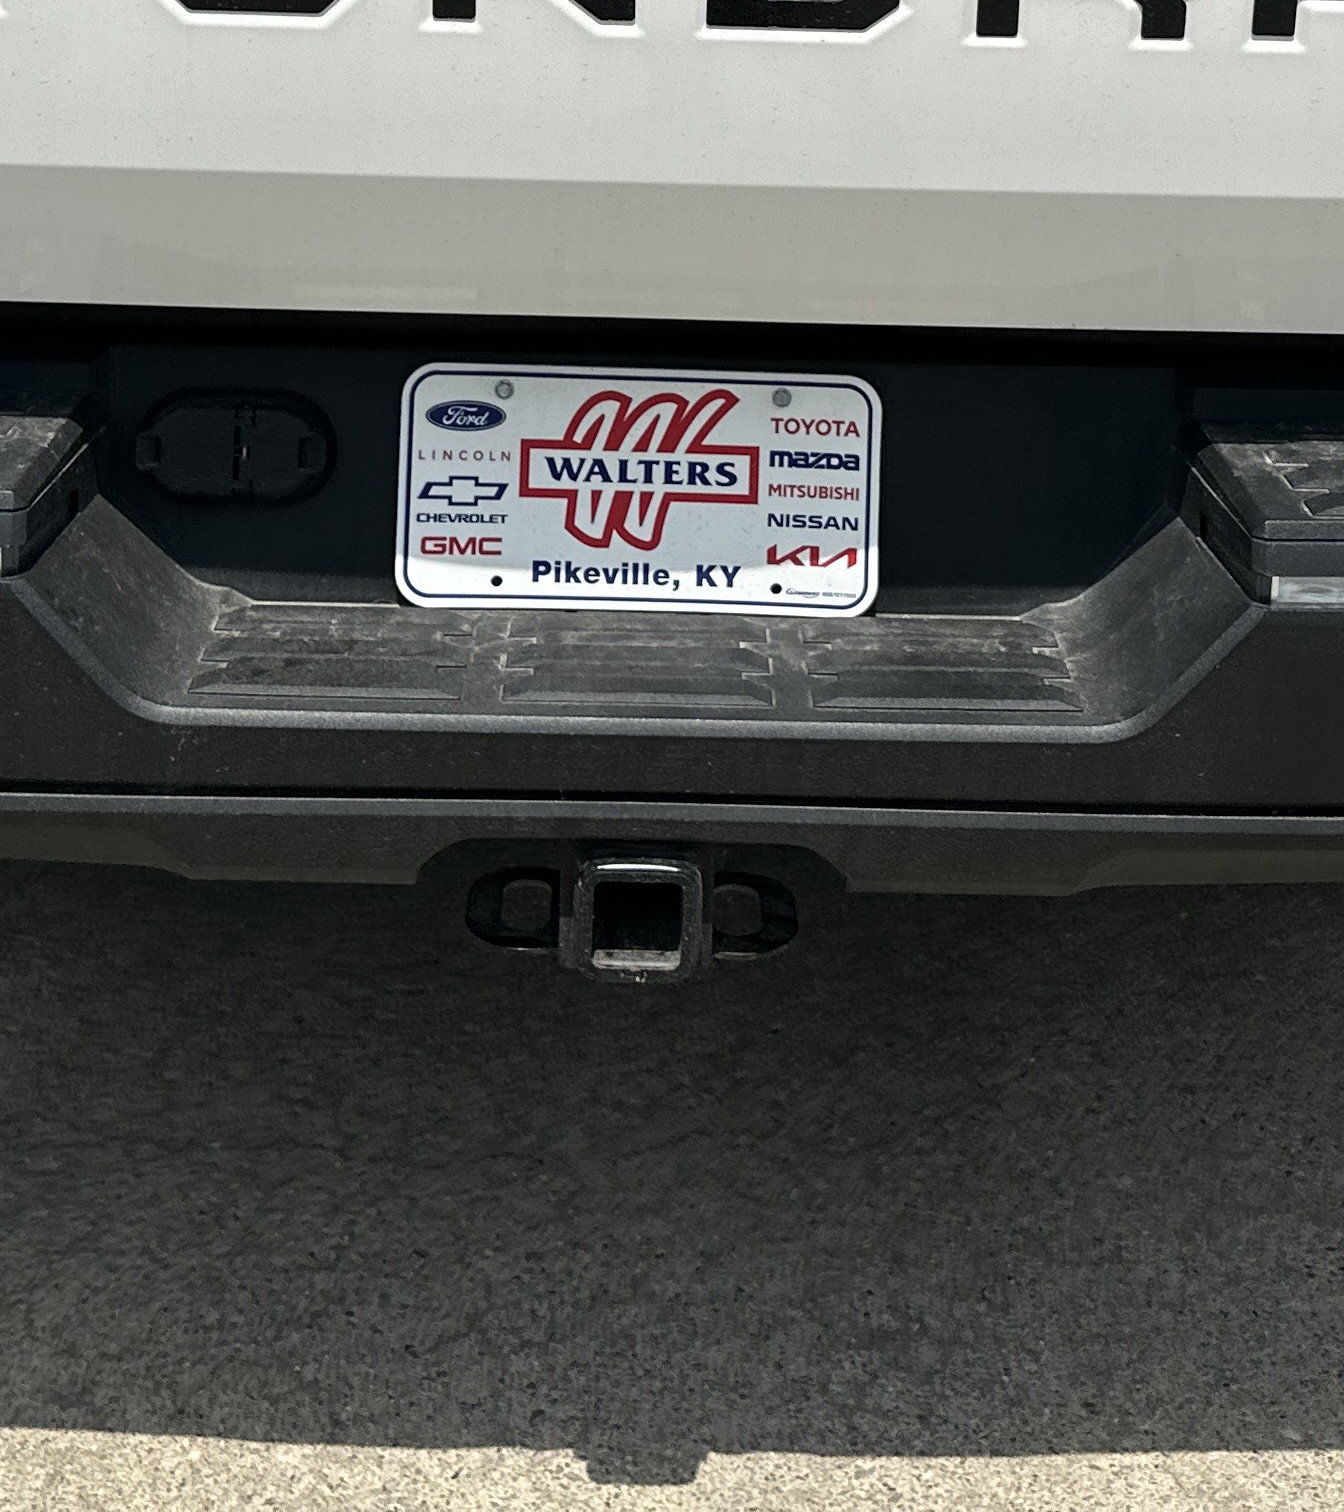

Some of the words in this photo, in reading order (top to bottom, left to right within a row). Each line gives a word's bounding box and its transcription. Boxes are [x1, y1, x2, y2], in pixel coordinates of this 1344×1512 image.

[442, 405, 489, 427] Ford
[770, 417, 861, 438] TOYOTA
[417, 449, 512, 462] LINCOLN
[545, 455, 739, 488] WALTERS
[768, 483, 860, 501] MITSUBISHI
[416, 512, 509, 524] CHEVROLET
[767, 513, 859, 531] NISSAN
[420, 536, 503, 556] GMC
[766, 544, 857, 569] KIA
[531, 559, 681, 591] Pikeville,
[696, 564, 742, 588] KY
